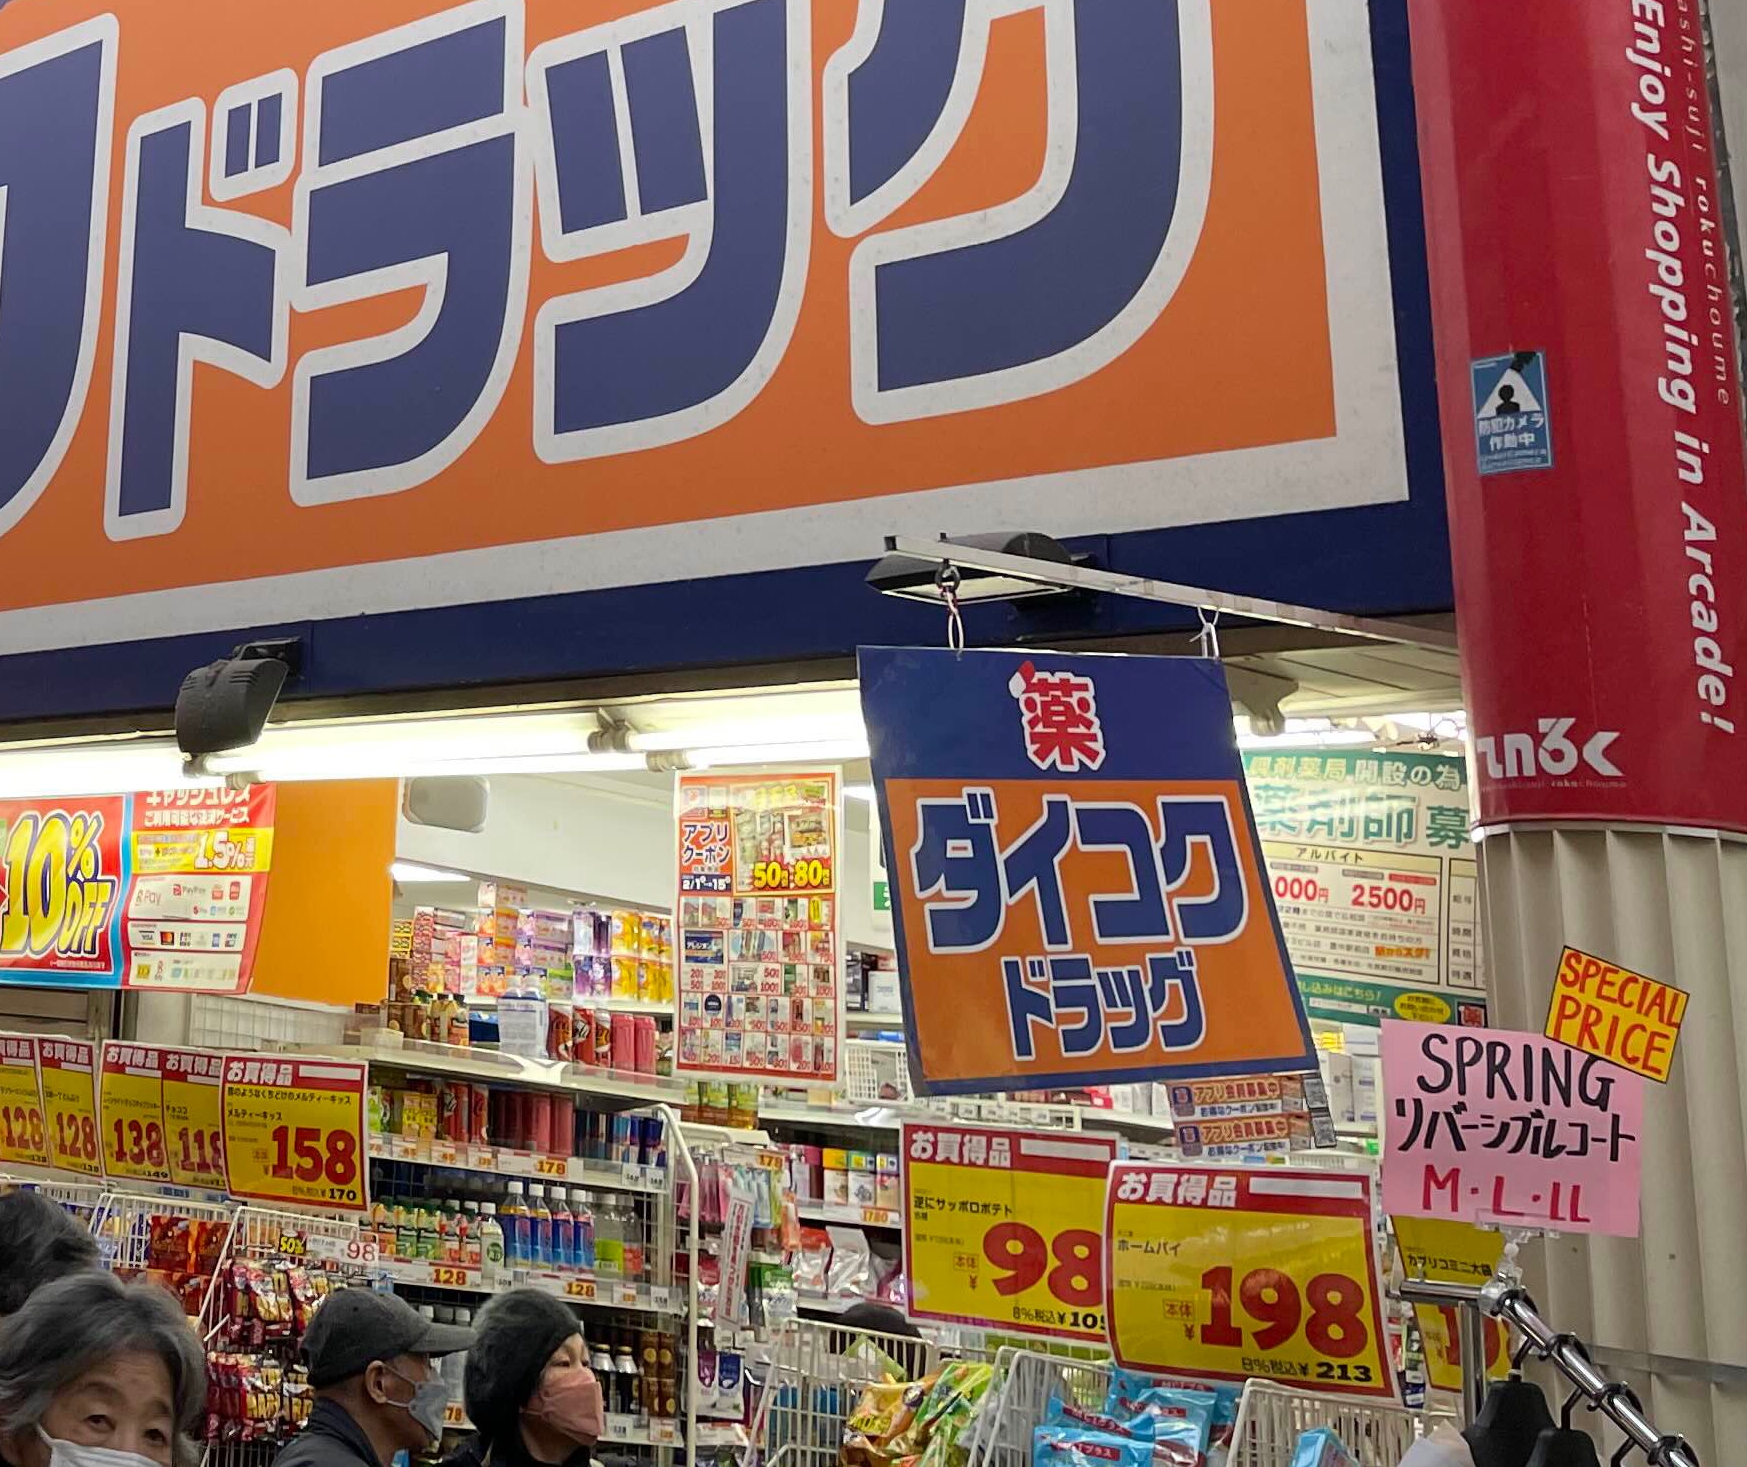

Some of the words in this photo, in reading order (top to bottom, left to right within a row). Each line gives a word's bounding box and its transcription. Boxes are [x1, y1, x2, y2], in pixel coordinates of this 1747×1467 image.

[1645, 152, 1699, 416] Shopping
[1693, 177, 1730, 406] rokuchoume
[1478, 413, 1545, 437] 防犯カメラ
[1489, 432, 1536, 451] 作動中
[1674, 429, 1711, 486] in
[1682, 501, 1736, 734] Arcade!
[1009, 661, 1106, 773] 薬
[1354, 759, 1461, 792] 開設の為
[682, 821, 730, 844] アプリ
[682, 844, 731, 865] クーポン
[909, 787, 1249, 954] ダイコク
[1296, 846, 1364, 863] アルバイト
[1350, 883, 1427, 915] 2500円
[57, 877, 117, 957] OFF
[1001, 947, 1207, 1061] ドラッグ
[1559, 951, 1682, 1030] SPECIAL
[1554, 995, 1672, 1076] PRICE
[41, 1042, 88, 1064] お買得品
[106, 1046, 159, 1069] お買得品
[166, 1053, 222, 1076] お買得品
[226, 1060, 293, 1086] お買得品
[1417, 1033, 1616, 1113] SPRING
[1, 1105, 45, 1152] 128
[227, 1108, 283, 1122] メルティーキッス
[1395, 1097, 1636, 1162] リバーシブルコート
[56, 1111, 97, 1161] 128
[113, 1117, 165, 1168] 138
[910, 1130, 1011, 1168] お買得品
[271, 1124, 357, 1186] 158
[536, 1159, 566, 1175] 178
[328, 1188, 357, 1201] 170
[1117, 1172, 1237, 1208] お買得品
[346, 1241, 376, 1262] 98
[955, 1255, 978, 1270] 本体
[983, 1221, 1103, 1308] 98
[1118, 1239, 1181, 1257] ホームパイ
[433, 1268, 467, 1286] 128
[566, 1281, 596, 1298] 128
[1165, 1302, 1192, 1318] 本体
[1200, 1266, 1368, 1359] 198
[1315, 1361, 1373, 1383] 213
